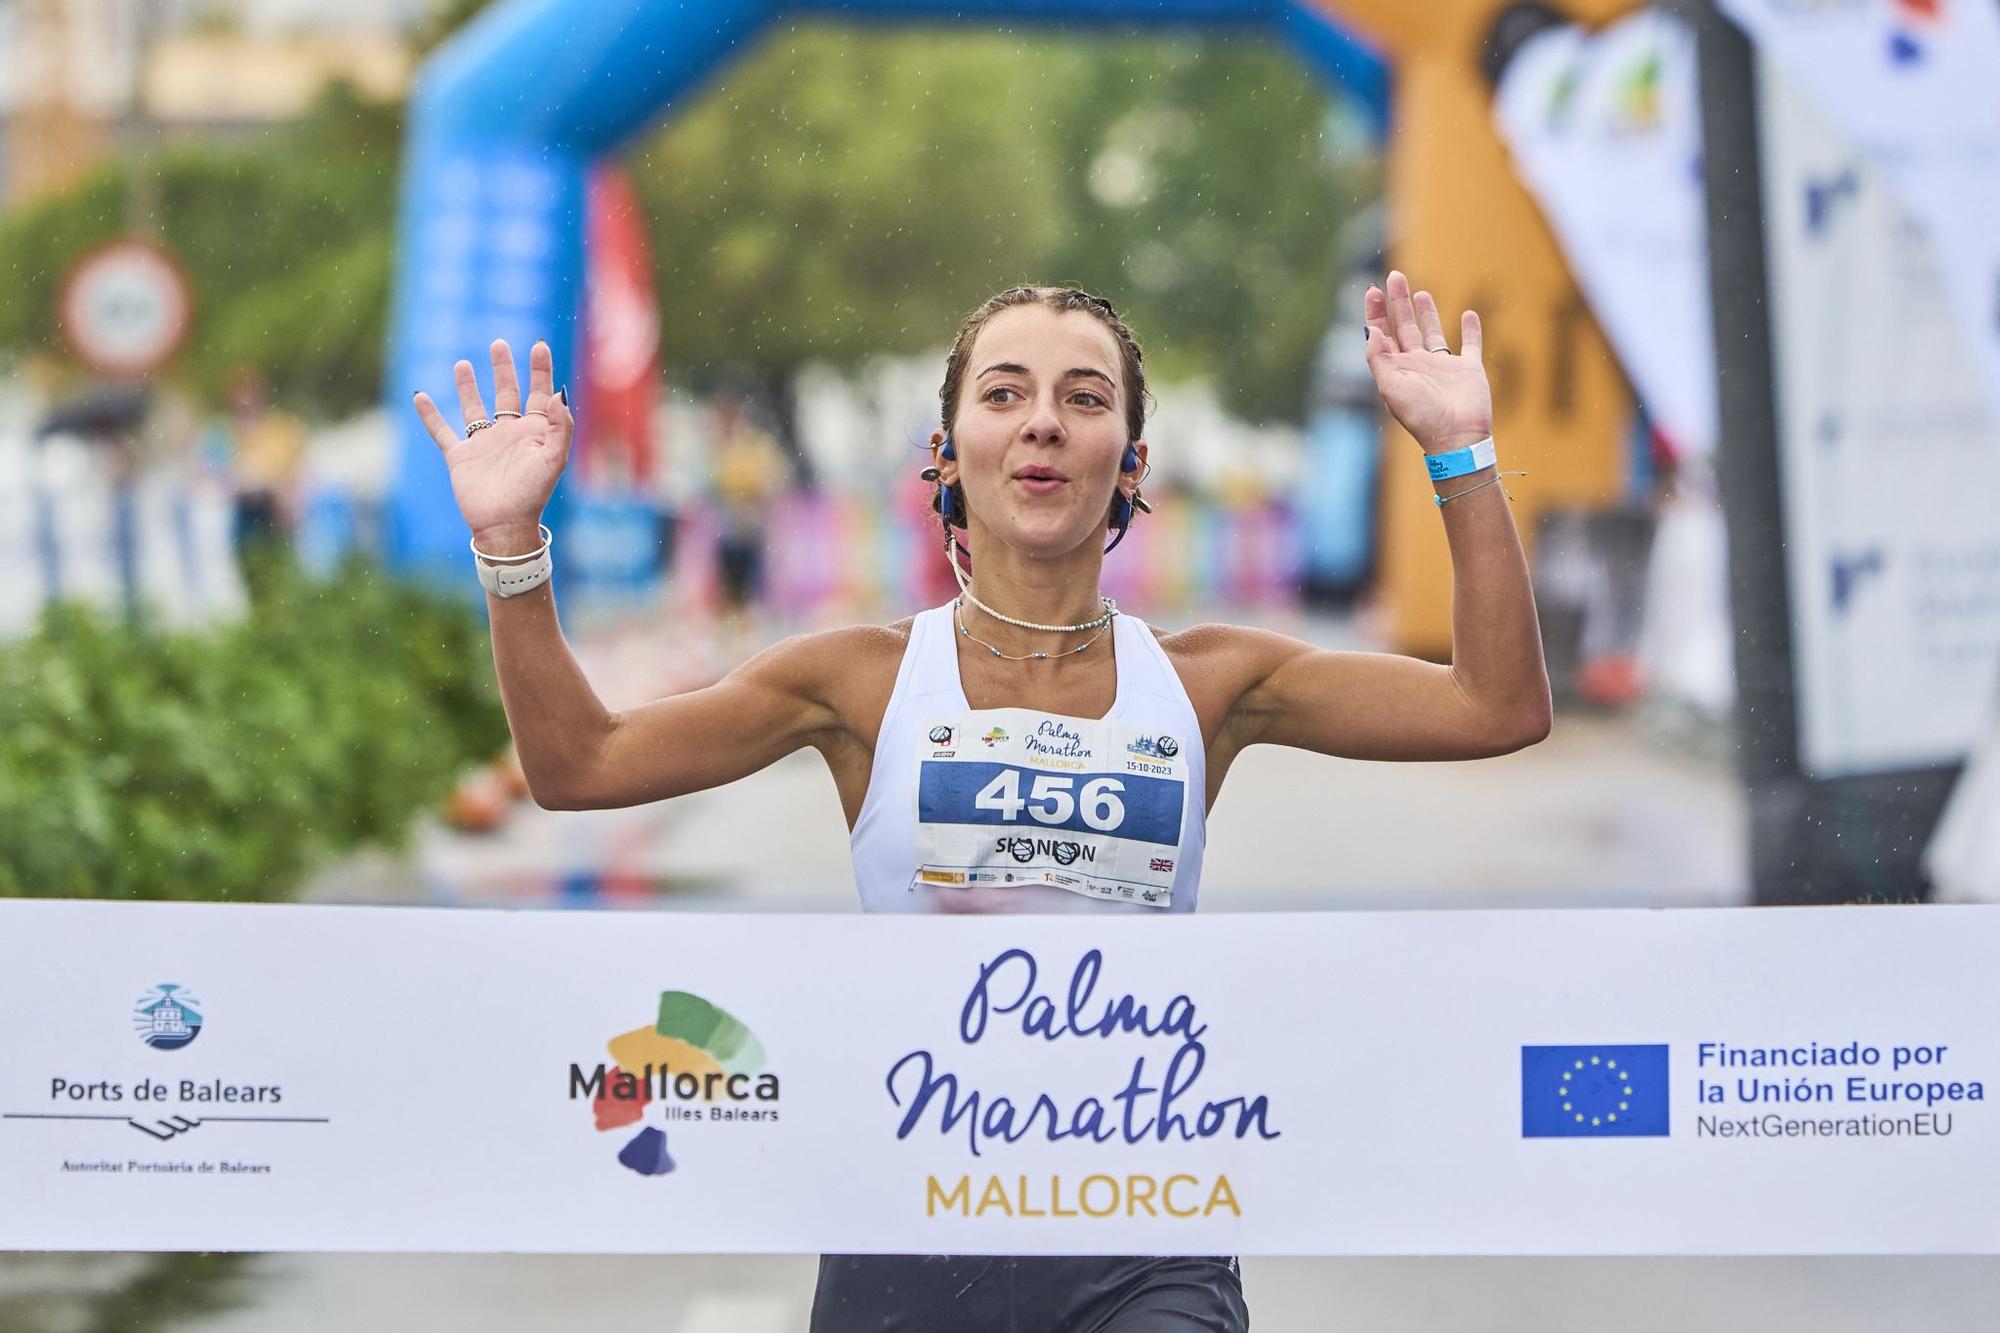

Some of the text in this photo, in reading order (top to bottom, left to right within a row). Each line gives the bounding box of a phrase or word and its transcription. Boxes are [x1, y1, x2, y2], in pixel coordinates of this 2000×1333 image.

[1037, 720, 1081, 742] Palma
[1024, 734, 1093, 758] Marathon
[1029, 756, 1086, 770] MALLORCA
[975, 769, 1126, 832] 456
[959, 948, 1208, 1045] Palma
[1698, 1041, 1949, 1072] Financiado por
[51, 1077, 282, 1104] Ports de Balears
[569, 1062, 780, 1101] Mallorca
[1698, 1077, 1985, 1108] la Unión Europea
[886, 1041, 1282, 1157] Marathon
[664, 1107, 779, 1122] Illes Balears
[1697, 1112, 1953, 1138] NextGenerationEU
[61, 1159, 122, 1173] Autoritat
[197, 1160, 215, 1174] de
[219, 1161, 271, 1175] Balears
[926, 1174, 1242, 1218] MALLORCA
